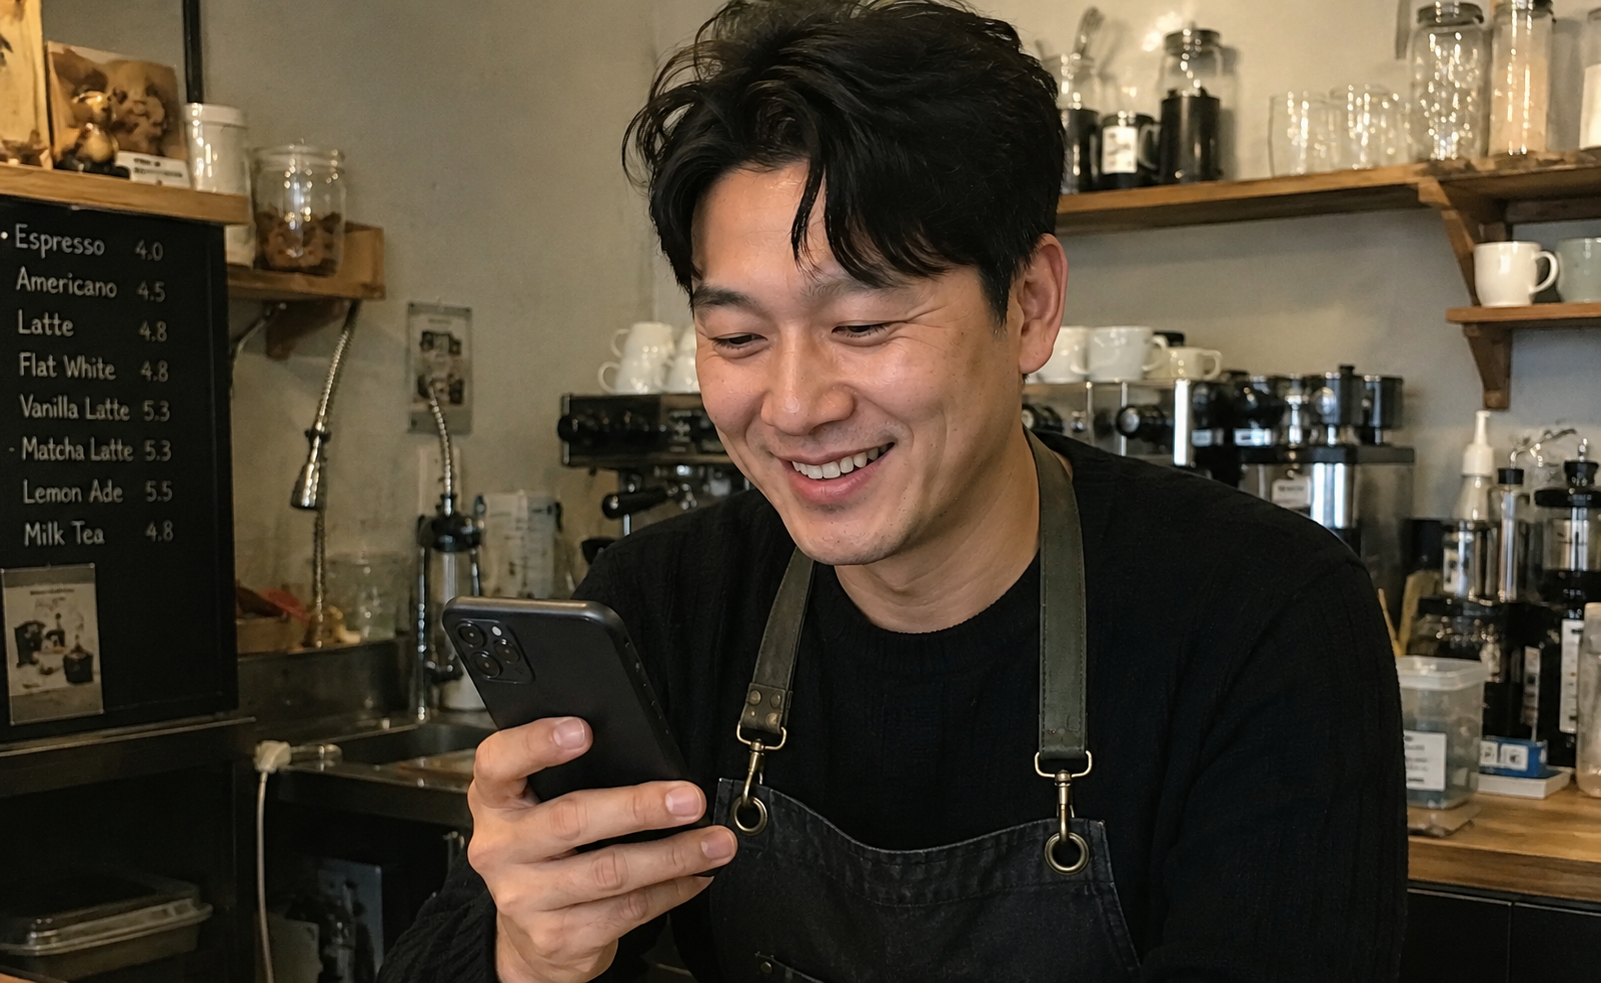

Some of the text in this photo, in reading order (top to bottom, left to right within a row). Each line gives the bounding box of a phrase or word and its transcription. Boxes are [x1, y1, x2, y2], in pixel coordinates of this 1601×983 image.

[15, 223, 164, 261] Espresso 4.0
[16, 265, 166, 302] Americano 4.5
[18, 308, 168, 342] Latte 4.8
[19, 352, 169, 382] Flat White 4.8
[19, 393, 171, 422] Vanilla Latte 5.3
[22, 436, 172, 462] Matcha Latte 5.3
[23, 478, 173, 504] Lemon Ade 5.5
[24, 519, 174, 547] Milk Tea 4.8
